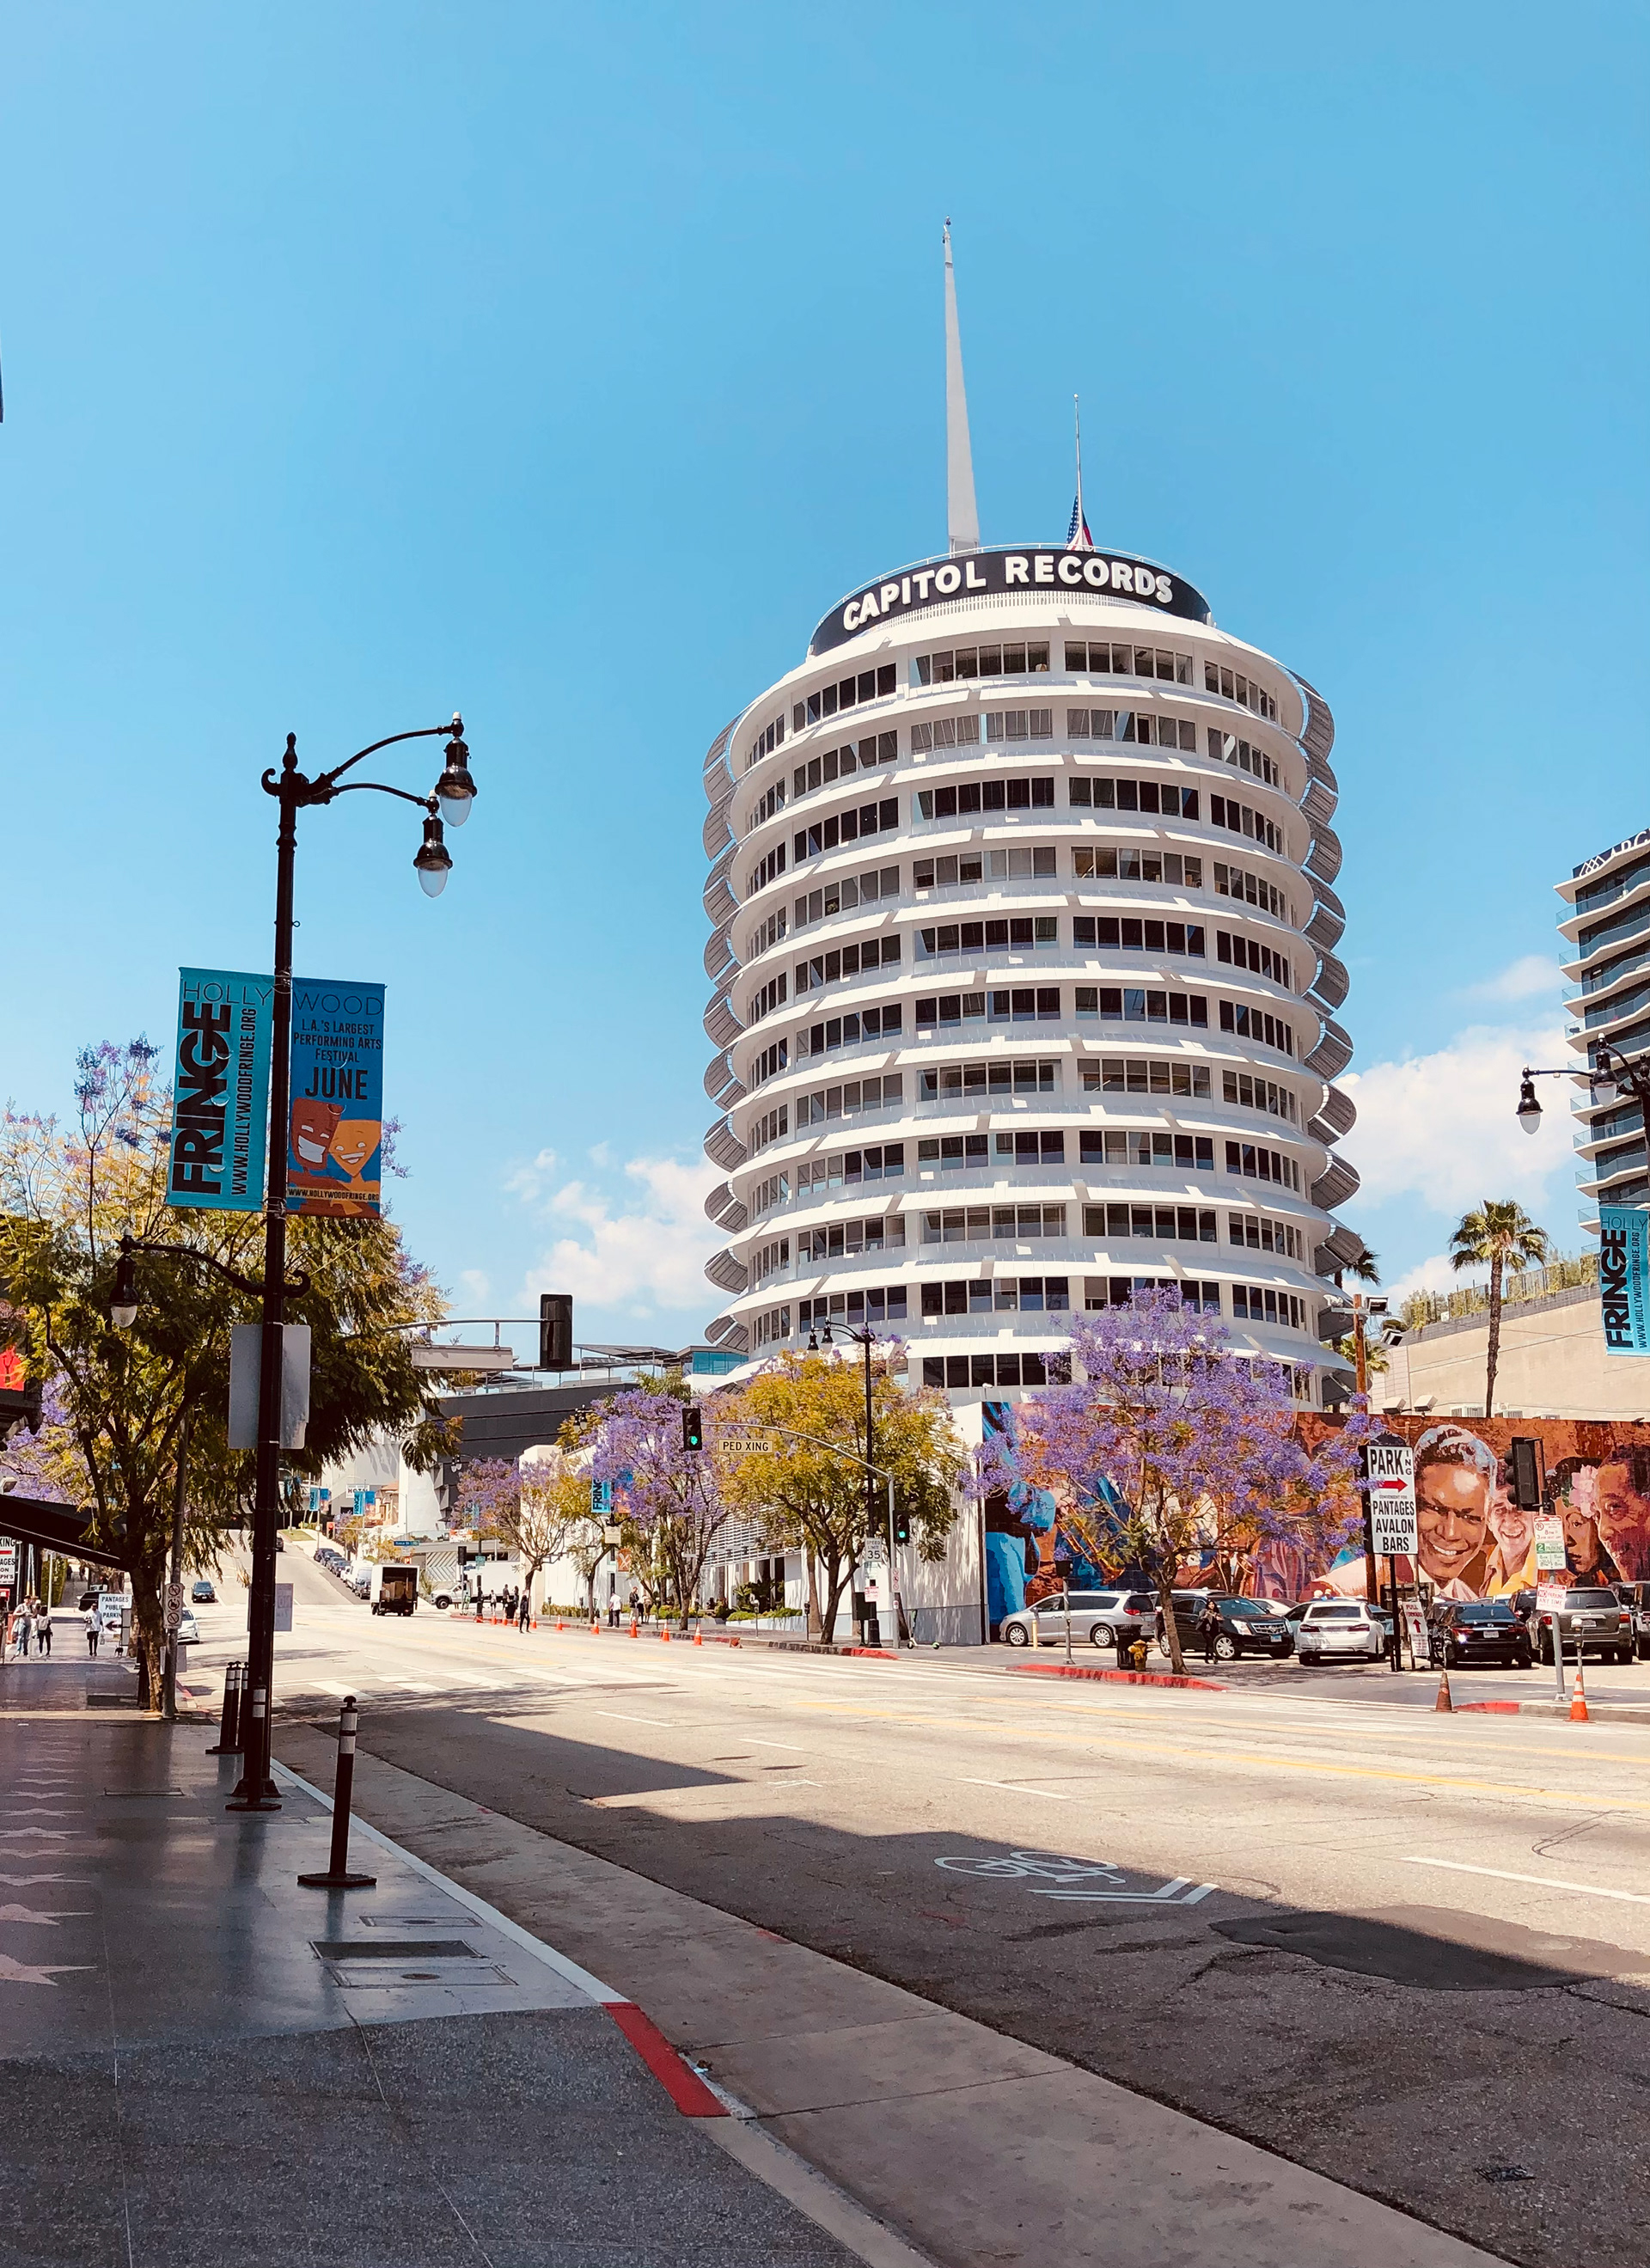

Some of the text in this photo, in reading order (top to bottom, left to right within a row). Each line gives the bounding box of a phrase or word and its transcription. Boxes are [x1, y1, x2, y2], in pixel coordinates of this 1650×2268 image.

[842, 555, 1174, 631] CAPITOL RECORDS
[183, 981, 273, 1006] HOLLY
[292, 992, 382, 1016] WOOD
[333, 1021, 375, 1035] LARGEST
[294, 1032, 382, 1049] PERFORMING ARTS
[315, 1048, 359, 1062] FESTIVAL
[305, 1067, 368, 1100] JUNE
[172, 1001, 232, 1195] FRINGE
[231, 1008, 256, 1195] WWW.HOLLYWOODFRINGE.ORG
[287, 1189, 380, 1201] WWW.HOLLYWOODFRINGE.ORG
[1601, 1216, 1648, 1231] HOLLY
[1601, 1230, 1635, 1348] FRINGE
[1631, 1232, 1647, 1349] WWW.HOLLYWOODFRINGE.ORG
[723, 1441, 769, 1452] PED XING
[1372, 1501, 1415, 1516] PANTAGES
[1376, 1519, 1414, 1533] AVALON
[1383, 1537, 1409, 1551] BARS
[867, 1550, 881, 1559] 35
